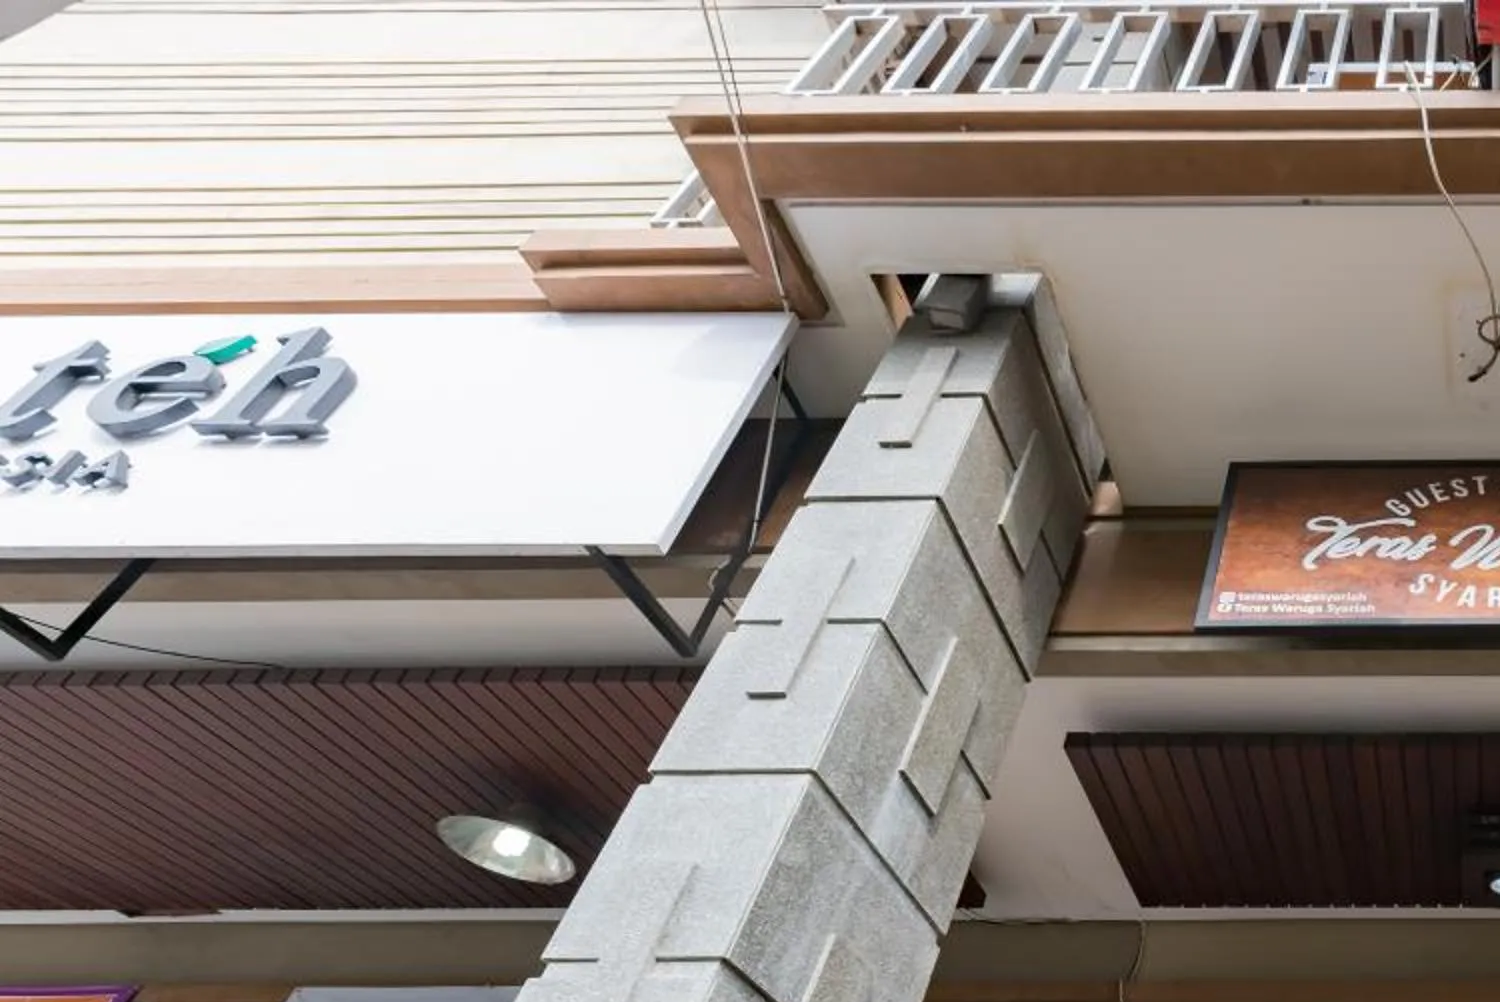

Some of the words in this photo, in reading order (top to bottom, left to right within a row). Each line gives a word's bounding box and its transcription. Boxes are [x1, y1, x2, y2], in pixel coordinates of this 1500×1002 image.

[0, 450, 132, 488] SIA
[1384, 475, 1488, 517] GUEST
[1302, 515, 1437, 571] Teras
[1272, 604, 1323, 615] Waruga
[1327, 604, 1376, 616] Syariah
